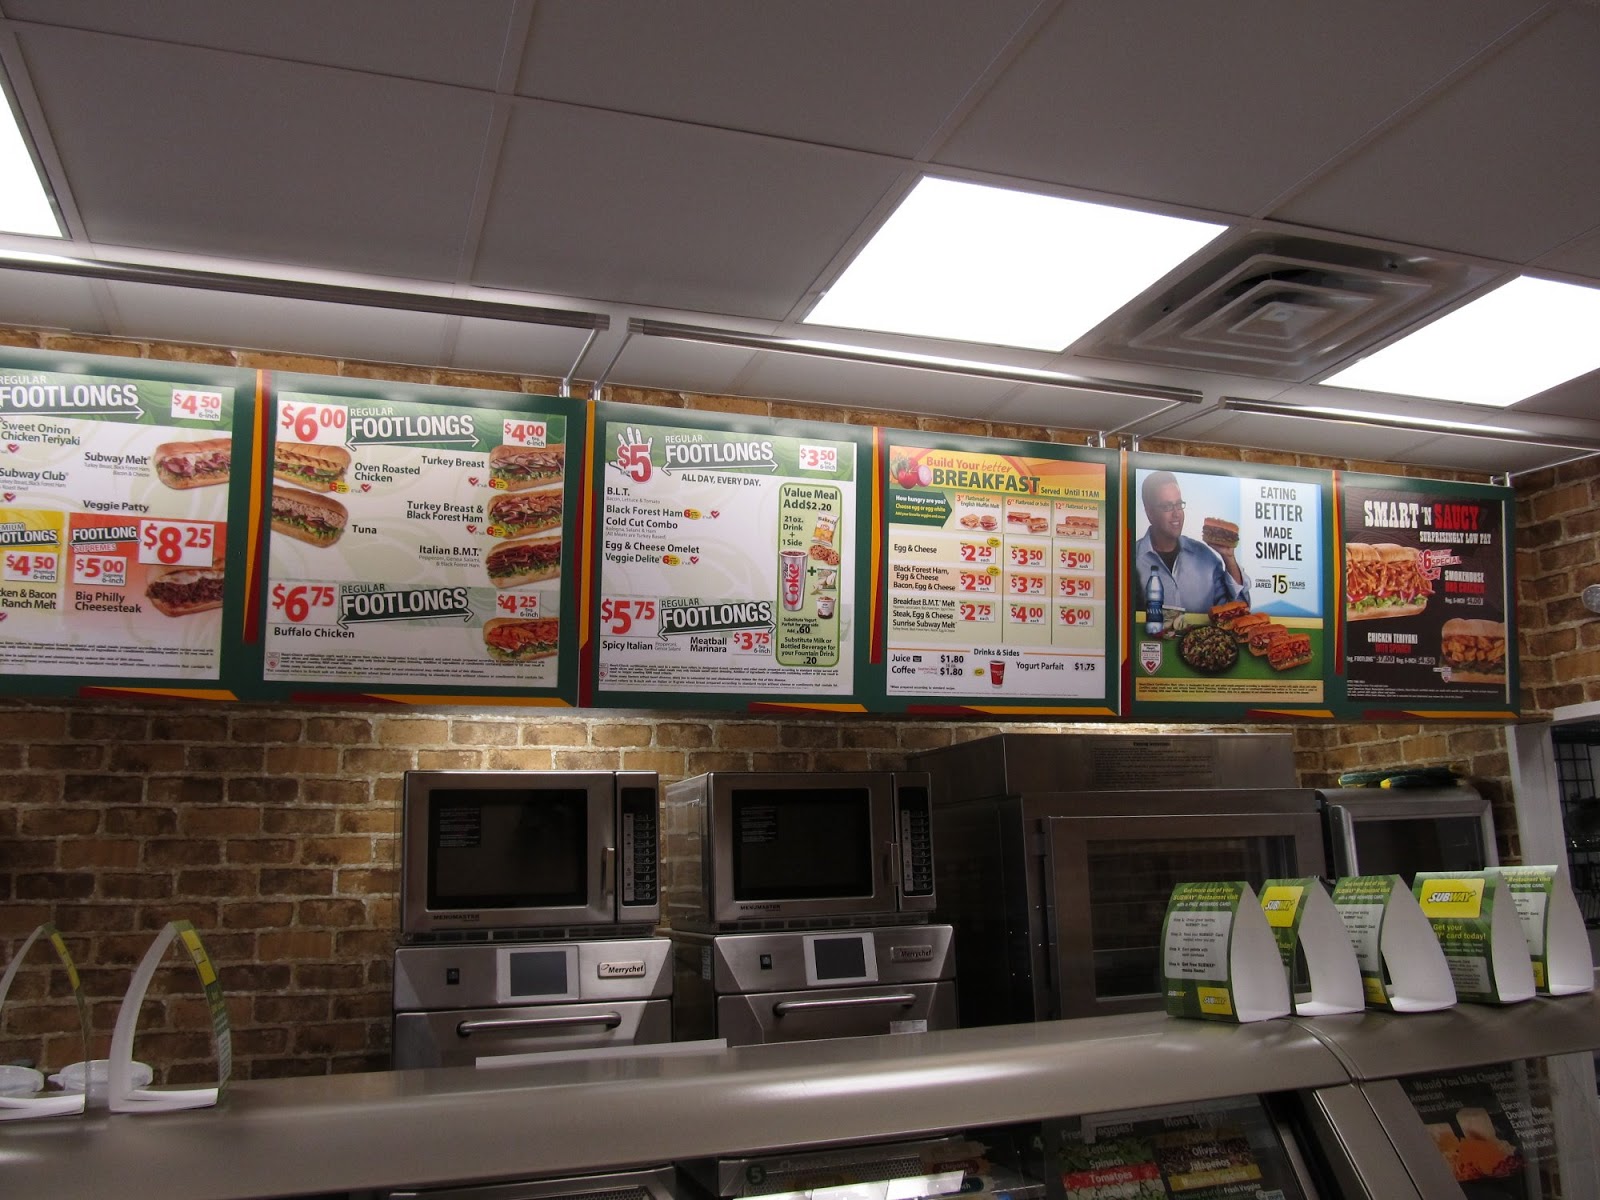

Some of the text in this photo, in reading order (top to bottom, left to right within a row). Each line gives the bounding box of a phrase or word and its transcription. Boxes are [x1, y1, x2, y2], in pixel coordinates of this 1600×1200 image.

[0, 384, 139, 408] FOOTLONGS
[350, 408, 393, 416] REGULAR
[2, 421, 70, 435] Sweet Onion
[351, 415, 474, 438] FOOTLONGS
[1, 431, 80, 446] Chicken Teriyaki
[665, 435, 702, 443] REGULAR
[665, 442, 773, 463] FOOTLONGS
[84, 452, 124, 465] Subway
[422, 456, 484, 468] Turkey Breast
[617, 444, 652, 483] $5
[355, 462, 420, 475] Oven Roasted
[926, 457, 1012, 472] Build Your better
[0, 468, 65, 481] Subway Club
[355, 472, 392, 482] Chicken
[682, 474, 761, 486] ALL DAY, EVERY DAY.
[933, 468, 1040, 494] BREAKFAST
[607, 487, 630, 496] B.L.T.
[784, 487, 837, 500] Value Meal
[1041, 487, 1079, 496] Served Until
[1260, 486, 1296, 500] EATING
[83, 500, 149, 512] Veggie Patty
[407, 501, 474, 512] Turkey Breast
[908, 497, 925, 505] hungry
[407, 511, 483, 522] Black Forest Ham
[606, 505, 683, 517] Black Forest Ham
[1255, 502, 1303, 522] BETTER
[1364, 500, 1419, 529] SMART
[1434, 504, 1479, 530] SAUCY
[606, 517, 678, 529] Cold Cut Combo
[73, 527, 137, 540] FOOTLONG
[352, 525, 377, 534] Tuna
[1264, 526, 1292, 539] MADE
[1419, 531, 1491, 545] SURPRISINGLY LOW FAT
[74, 544, 116, 552] SUPREMES
[419, 545, 450, 555] Italian
[606, 540, 699, 553] Egg Cheese Omelet
[894, 544, 937, 554] Egg Cheese
[1255, 541, 1302, 561] SIMPLE
[606, 553, 660, 564] Veggie Delite
[1419, 550, 1431, 570] $6
[1432, 556, 1461, 566] SPECIAL
[894, 565, 949, 575] Black Forest Ham,
[896, 572, 939, 581] Egg Cheese
[342, 584, 386, 593] REGULAR
[785, 563, 799, 606] Coke
[894, 581, 955, 592] Bacon, Egg Cheese
[1272, 574, 1287, 594] 15
[29, 590, 57, 599] Bacon
[76, 591, 125, 604] Big Philly
[2, 599, 56, 609] Ranch Melt
[75, 602, 141, 613] Cheesesteak
[342, 589, 468, 616] FOOTLONGS
[661, 598, 699, 607] REGULAR
[661, 602, 771, 628] FOOTLONGS
[893, 610, 910, 619] Steak,
[912, 611, 922, 621] Egg
[893, 620, 915, 628] Sunrise
[917, 620, 940, 630] Subway
[274, 627, 354, 638] Buffalo Chicken
[1368, 632, 1391, 643] CHICKEN
[602, 641, 625, 651] Spicy
[627, 642, 652, 650] Italian
[690, 637, 727, 645] Meatball
[690, 645, 727, 653] Marinara
[974, 648, 996, 656] Drinks
[892, 654, 964, 664] Juice $1.80
[892, 665, 963, 676] Coffee $1.80
[1016, 662, 1095, 671] Yogurt Parfait $1.75
[1427, 890, 1476, 903] SUBWAY
[608, 965, 643, 974] Merrychef
[1413, 1079, 1441, 1090] Would
[1441, 1076, 1458, 1086] You
[1089, 1158, 1125, 1169] Spinach
[1089, 1170, 1133, 1183] Tomatoes
